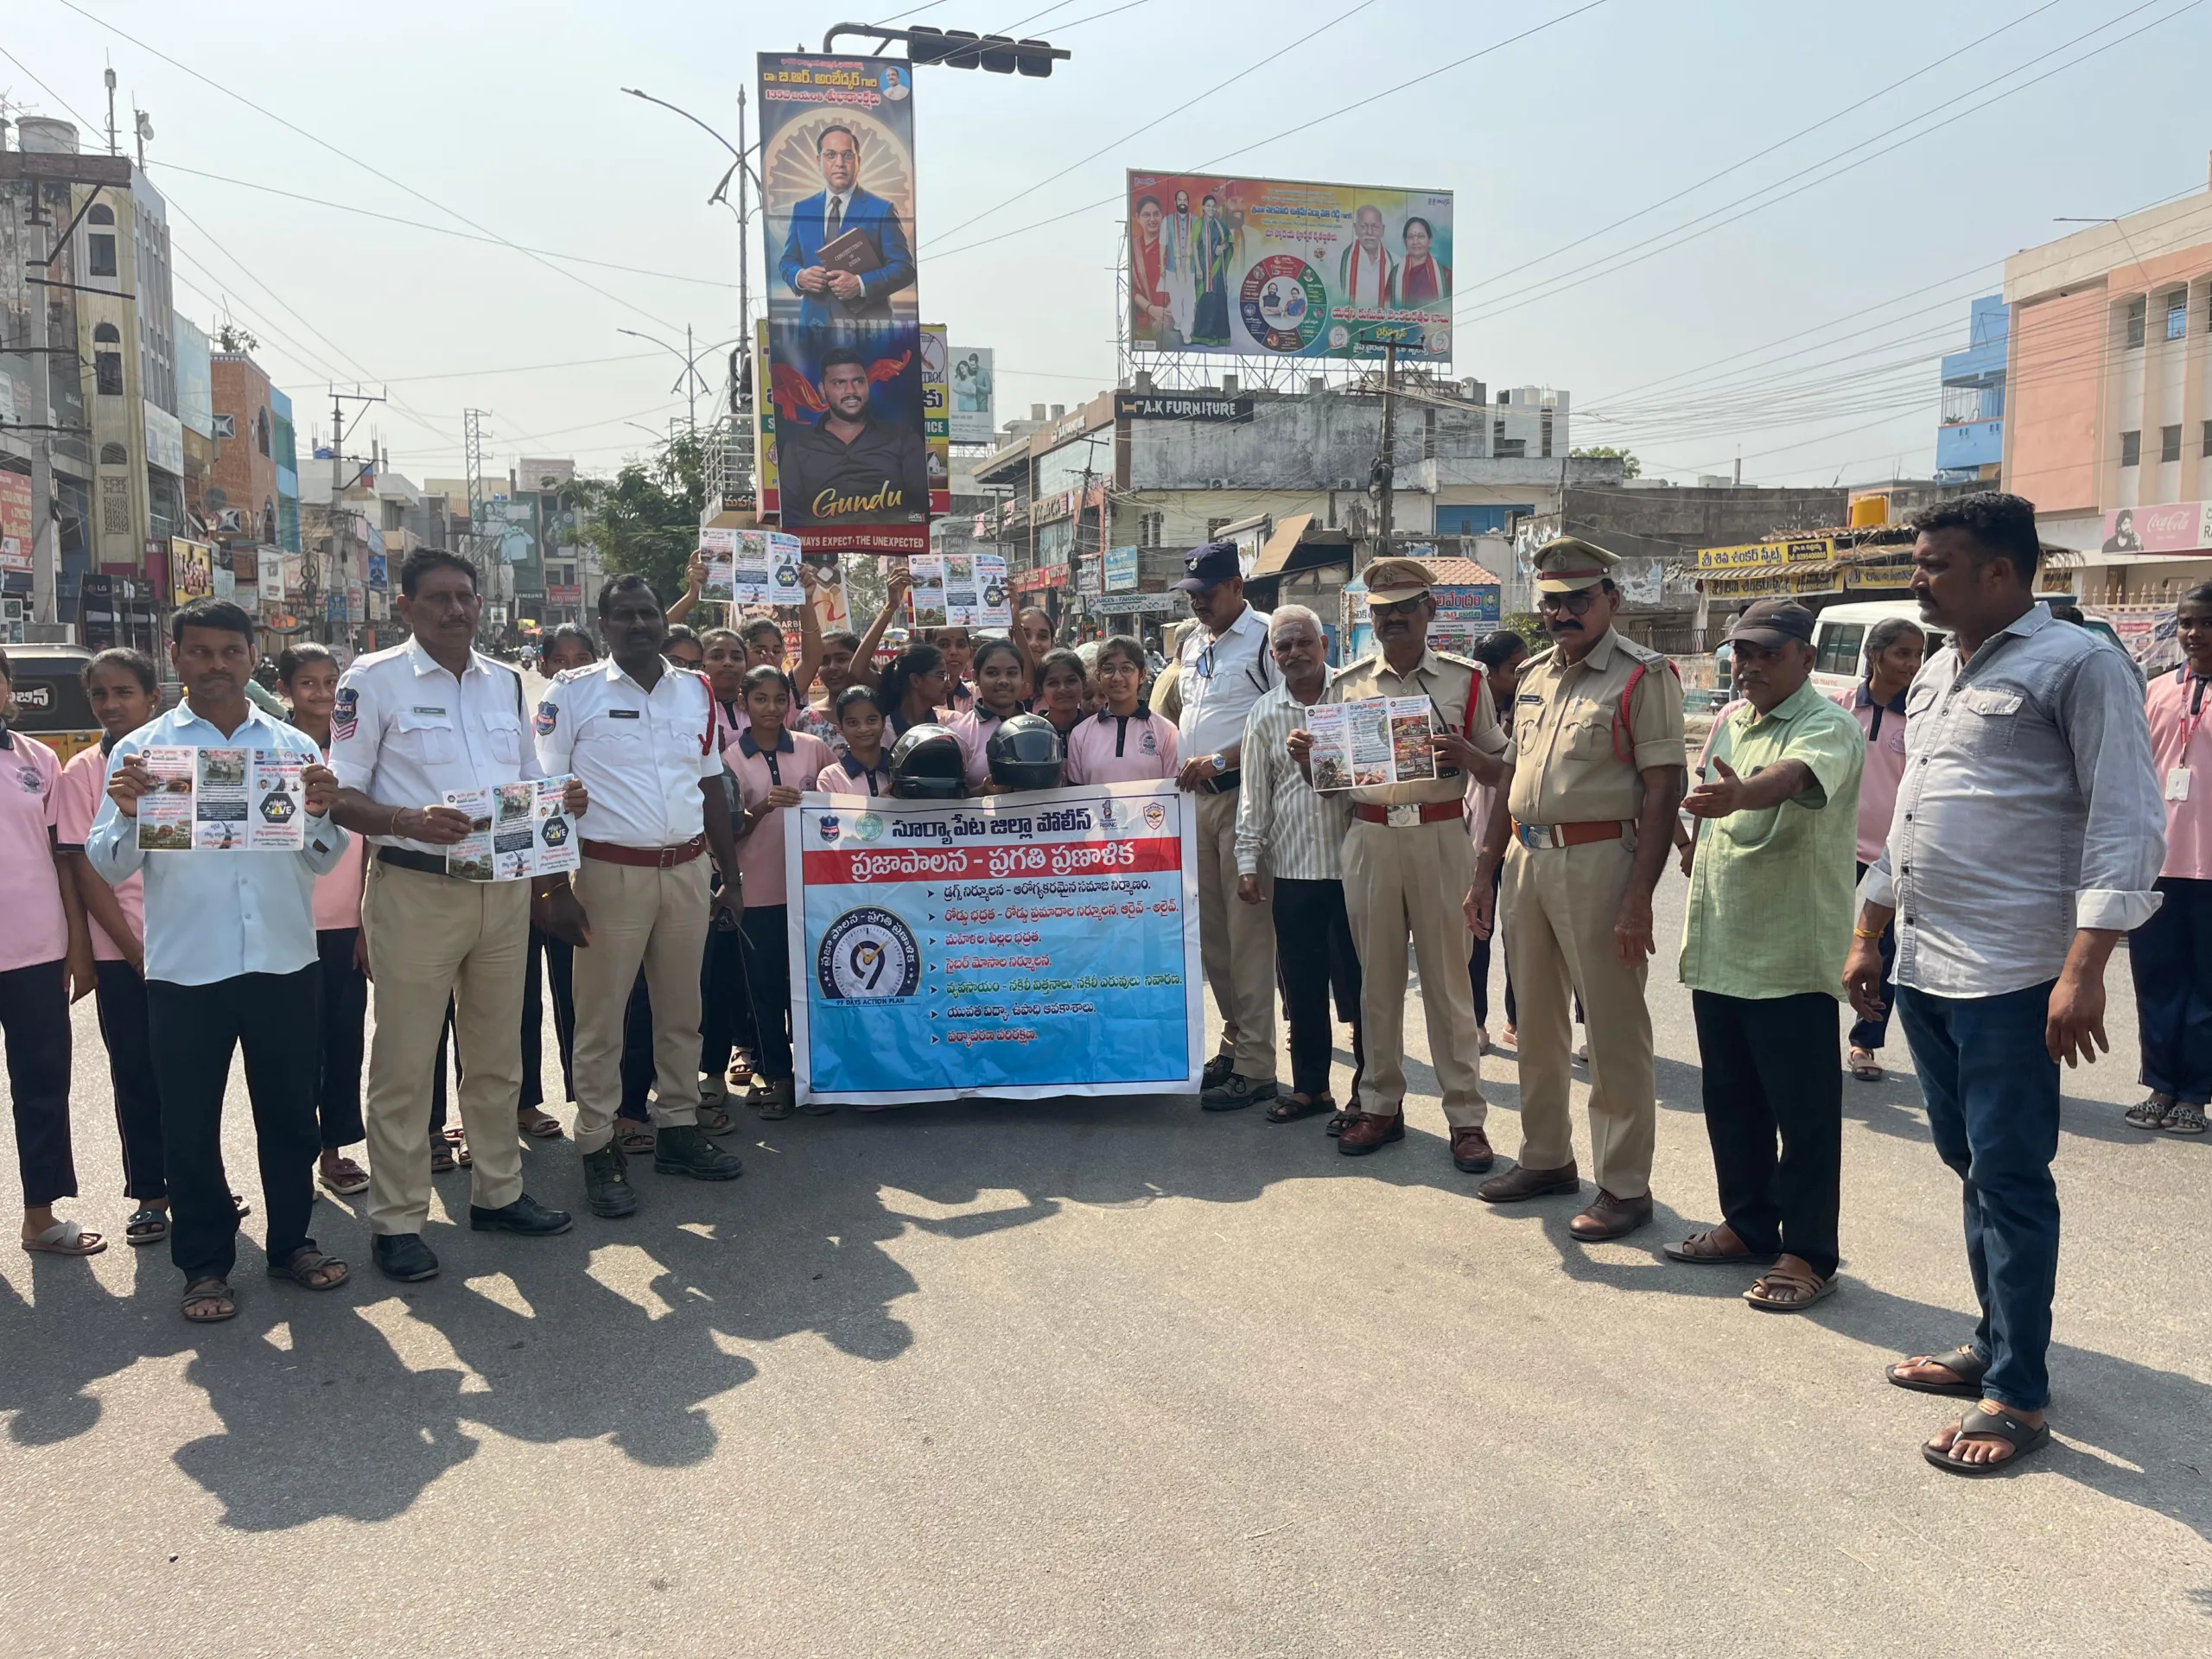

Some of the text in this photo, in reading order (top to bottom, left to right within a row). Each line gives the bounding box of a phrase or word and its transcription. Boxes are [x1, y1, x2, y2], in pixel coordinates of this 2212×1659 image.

[1166, 401, 1236, 418] FURNITURE
[812, 480, 902, 518] Gundu
[822, 536, 853, 547] EXPECT
[855, 535, 870, 547] THE
[872, 535, 924, 548] UNEXPECTED
[1732, 548, 1758, 563] శంకర్
[893, 808, 1091, 844] సూర్యాపేట జిల్లా పోలీస్
[851, 849, 967, 882] ప్రజాపాలన
[988, 846, 1046, 877] ప్రగతి
[1051, 842, 1135, 875] ప్రణాళిక
[963, 884, 1004, 901] నిర్మూలన
[1014, 880, 1077, 899] ఆరోగ్యకరమైన
[1078, 880, 1109, 893] సమాజ
[868, 912, 893, 925] ప్రగతి
[944, 907, 969, 926] రోడ్డు
[970, 908, 995, 924] భద్రత
[1005, 905, 1028, 923] రోడ్డు
[1031, 906, 1075, 922] ప్రమాదాల
[988, 931, 1012, 948] పిల్లల
[972, 957, 1007, 969] మోసాల
[947, 981, 1000, 999] వ్యవసాయం
